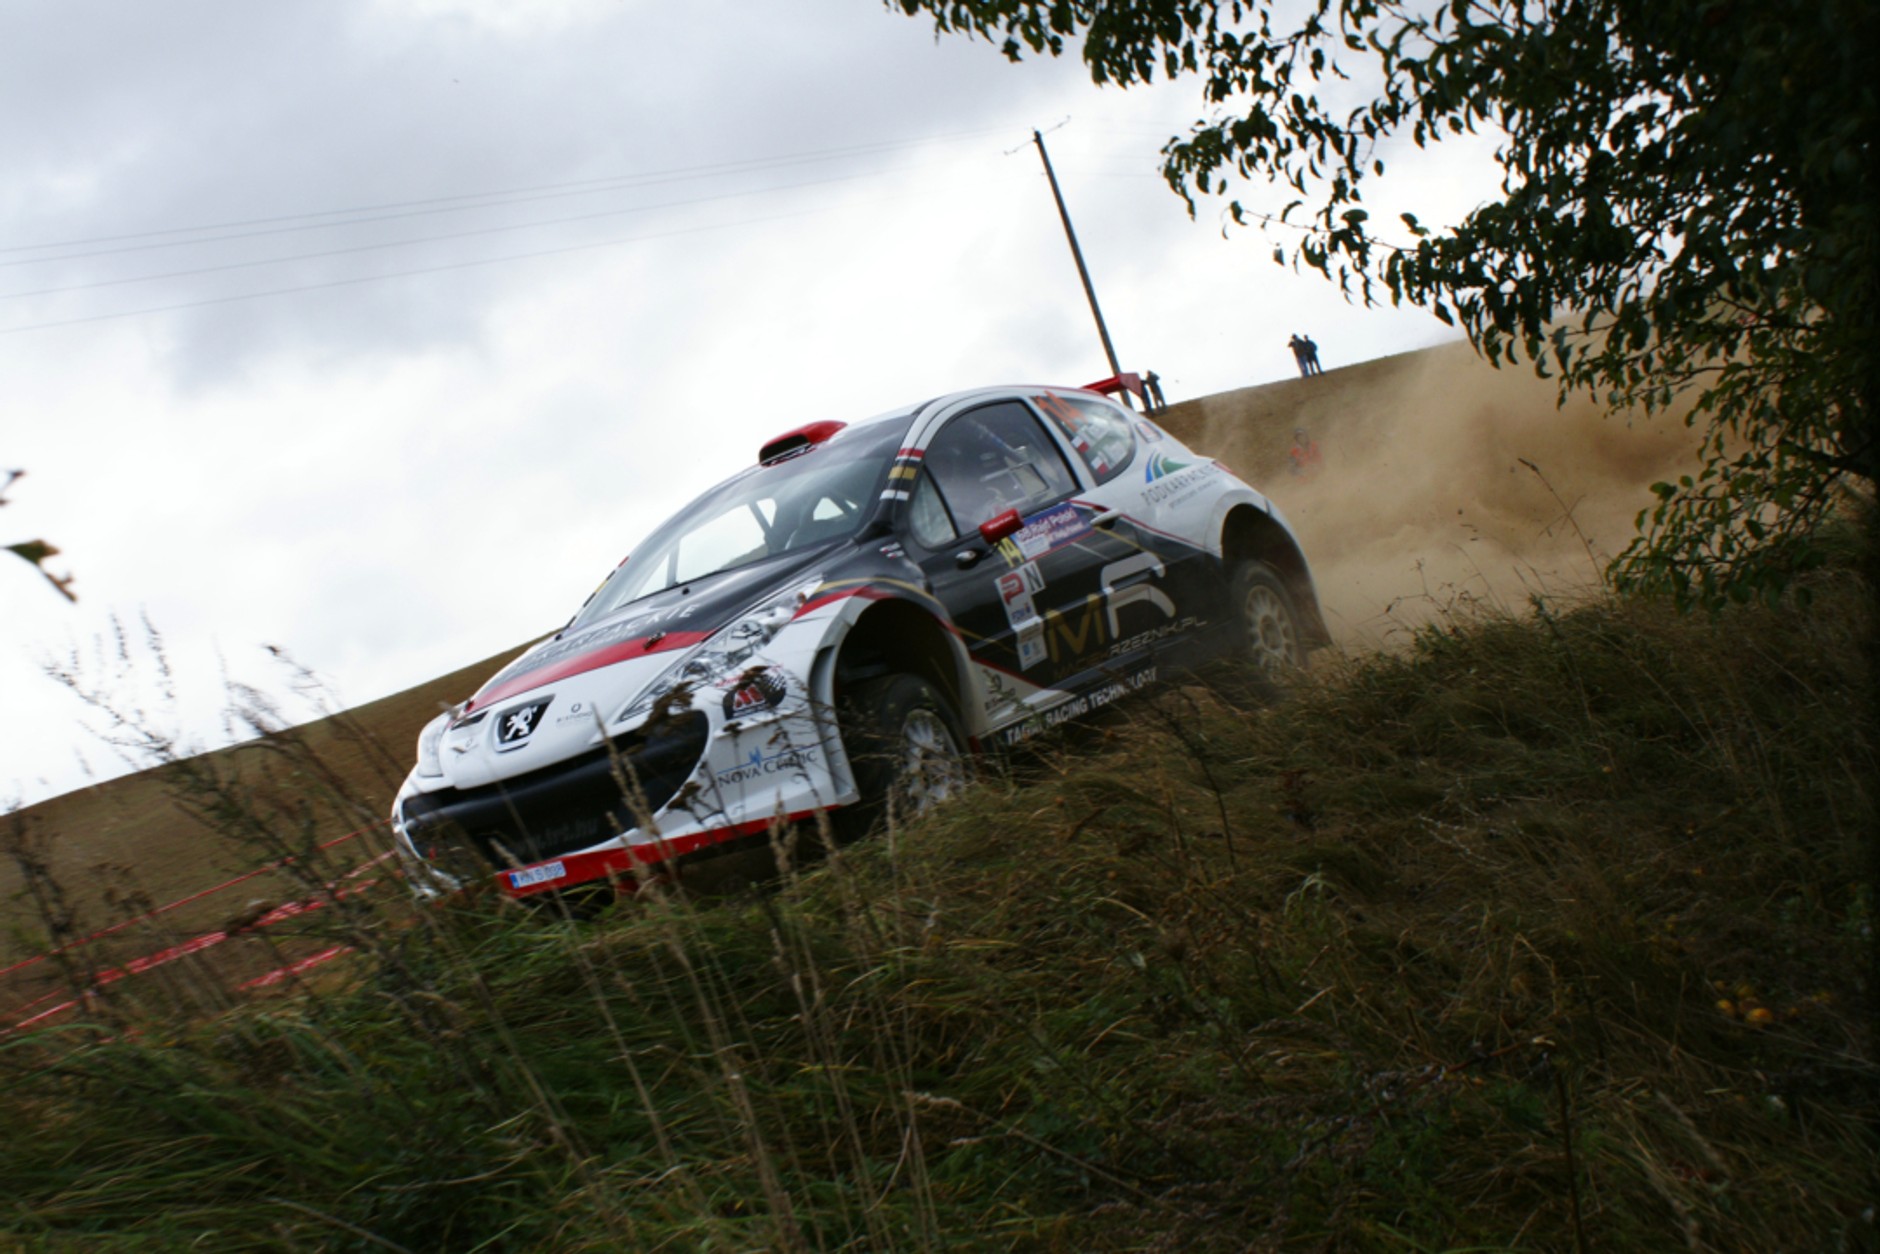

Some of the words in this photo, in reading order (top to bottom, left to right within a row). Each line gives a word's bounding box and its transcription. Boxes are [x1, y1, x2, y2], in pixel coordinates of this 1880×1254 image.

[993, 536, 1025, 569] 14
[1046, 699, 1088, 727] RACING
[718, 767, 761, 787] NOVA
